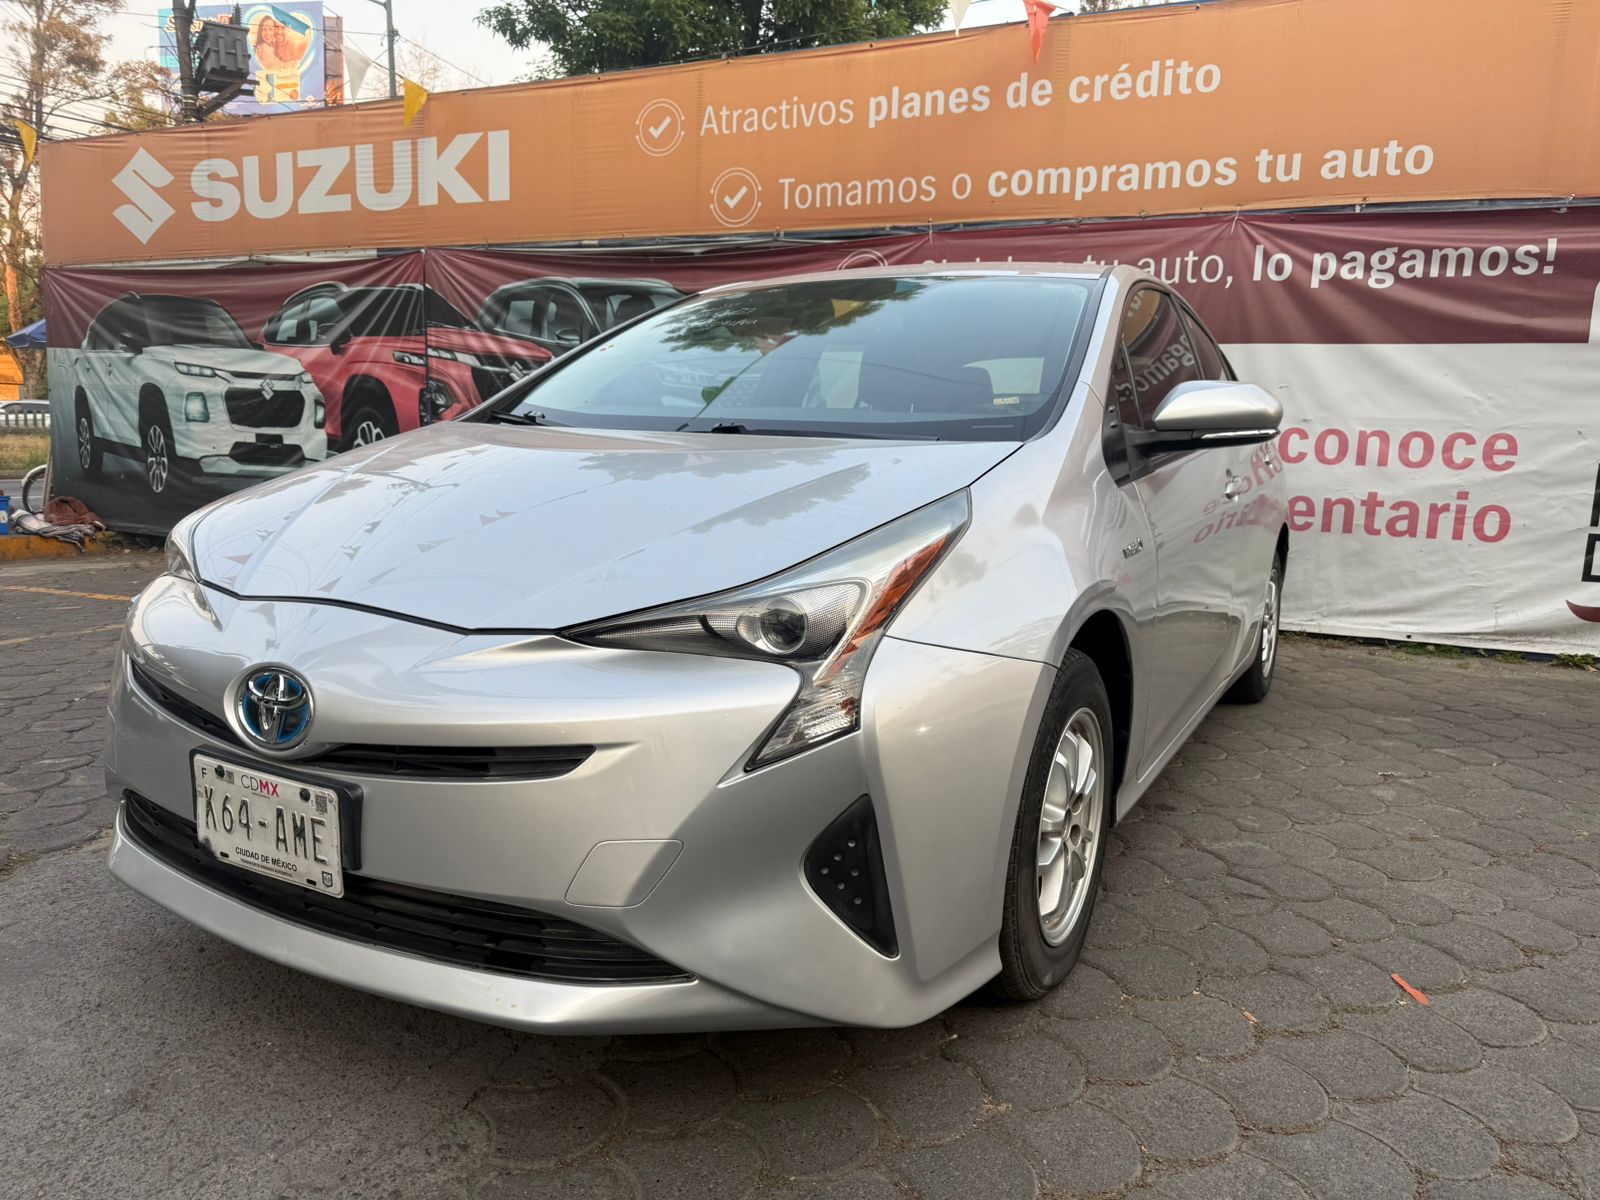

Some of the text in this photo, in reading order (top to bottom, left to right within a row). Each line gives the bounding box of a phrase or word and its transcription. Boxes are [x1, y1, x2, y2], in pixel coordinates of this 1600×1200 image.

[700, 58, 1222, 137] Atractivos planes de crédito
[190, 130, 511, 223] SUZUKI
[778, 139, 1435, 211] Tomamos o compramos tu auto
[1252, 244, 1293, 283] lo
[1310, 237, 1559, 289] pagamos!
[1277, 427, 1518, 472] conoce
[1286, 491, 1512, 543] entario
[240, 774, 280, 798] CDMX
[204, 784, 329, 866] K64-AME
[235, 846, 260, 861] CIUDAD
[260, 854, 270, 864] DE
[271, 857, 298, 872] MÉXICO
